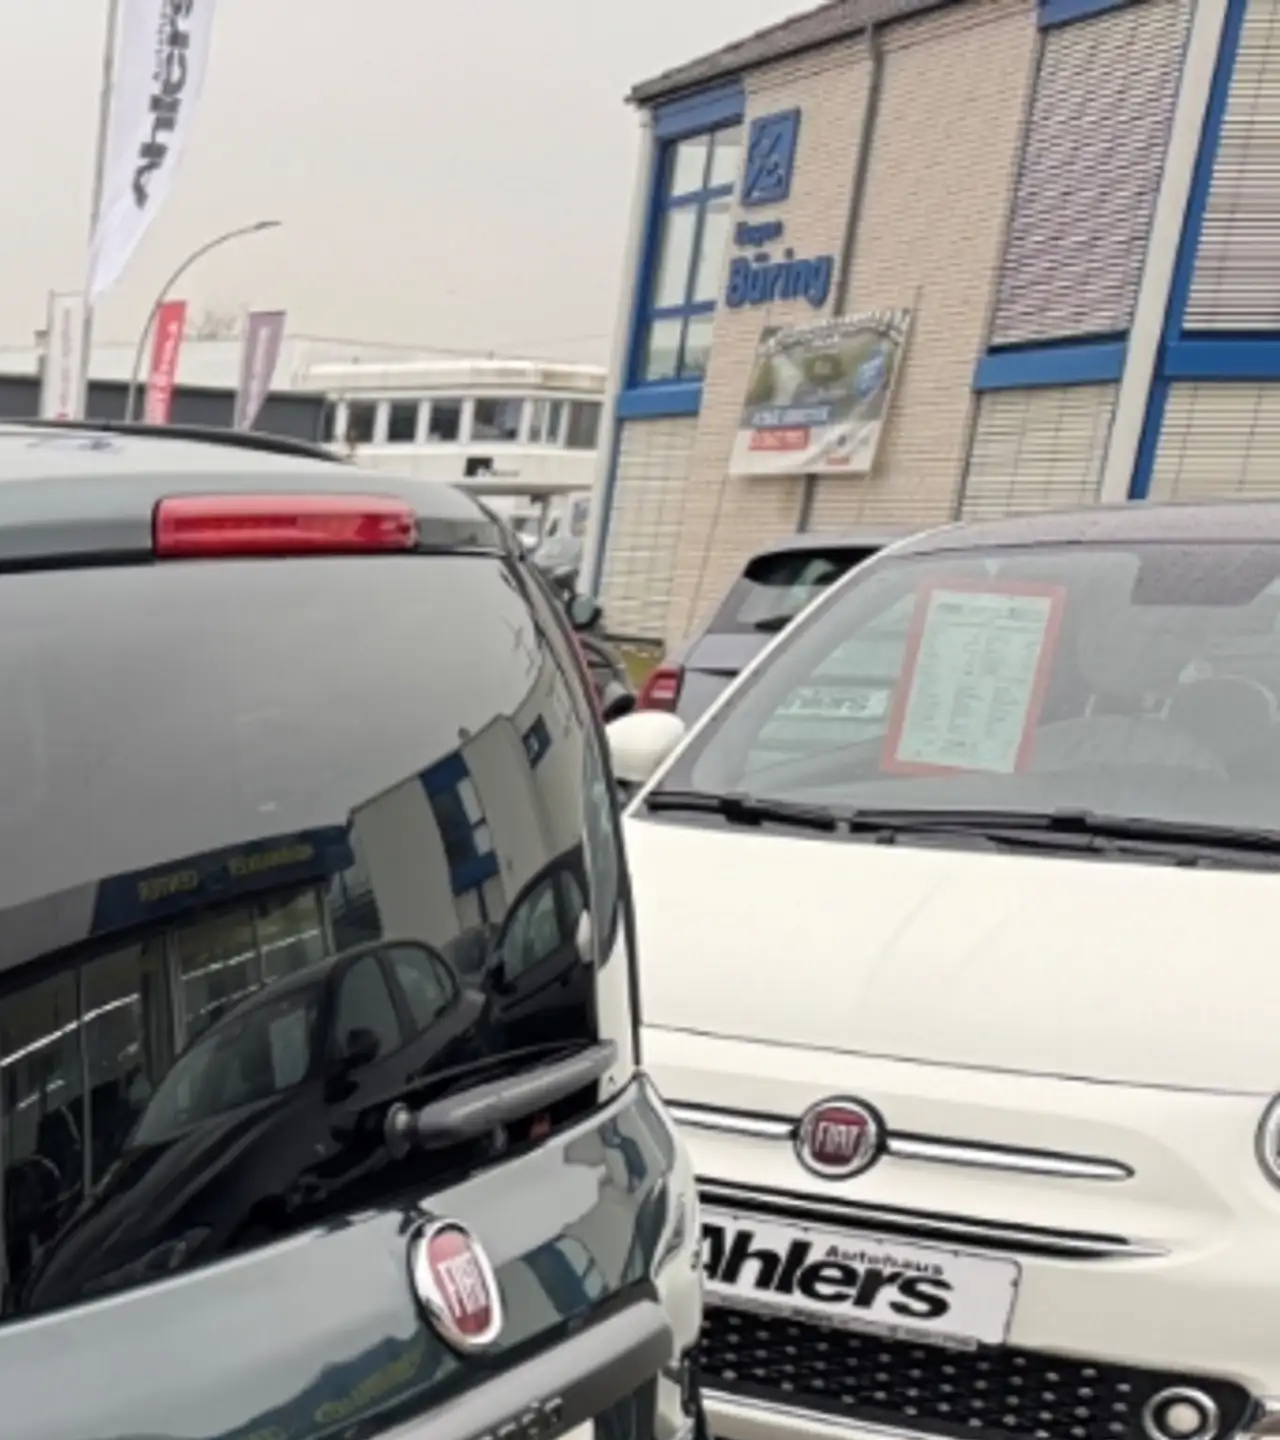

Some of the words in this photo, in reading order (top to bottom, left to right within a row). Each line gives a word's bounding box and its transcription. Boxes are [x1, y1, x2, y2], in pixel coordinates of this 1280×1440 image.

[726, 247, 834, 309] Büring
[815, 1121, 860, 1156] FIAT
[825, 1245, 944, 1276] Autohaus
